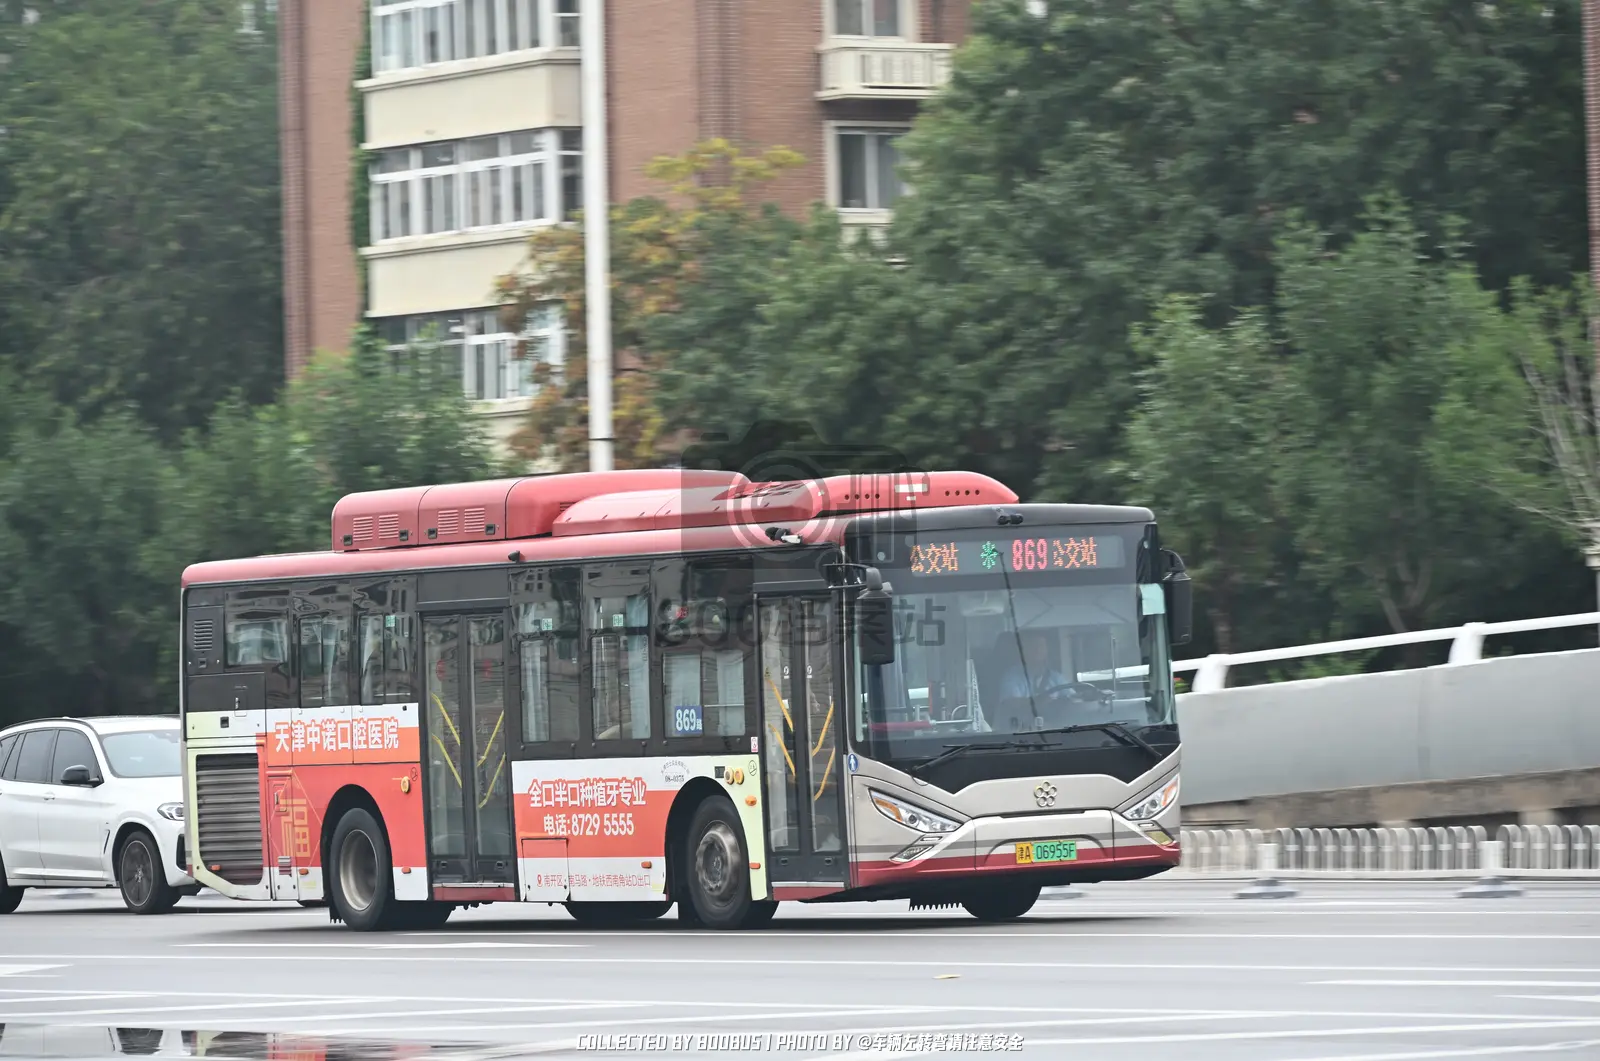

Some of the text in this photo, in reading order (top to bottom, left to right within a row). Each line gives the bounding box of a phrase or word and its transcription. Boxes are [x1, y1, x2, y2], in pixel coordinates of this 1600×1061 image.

[1012, 538, 1048, 571] 869
[275, 718, 399, 753] 天津中诺口腔医院
[528, 778, 647, 808] 全口半口种植牙专业
[603, 812, 634, 836] 5555
